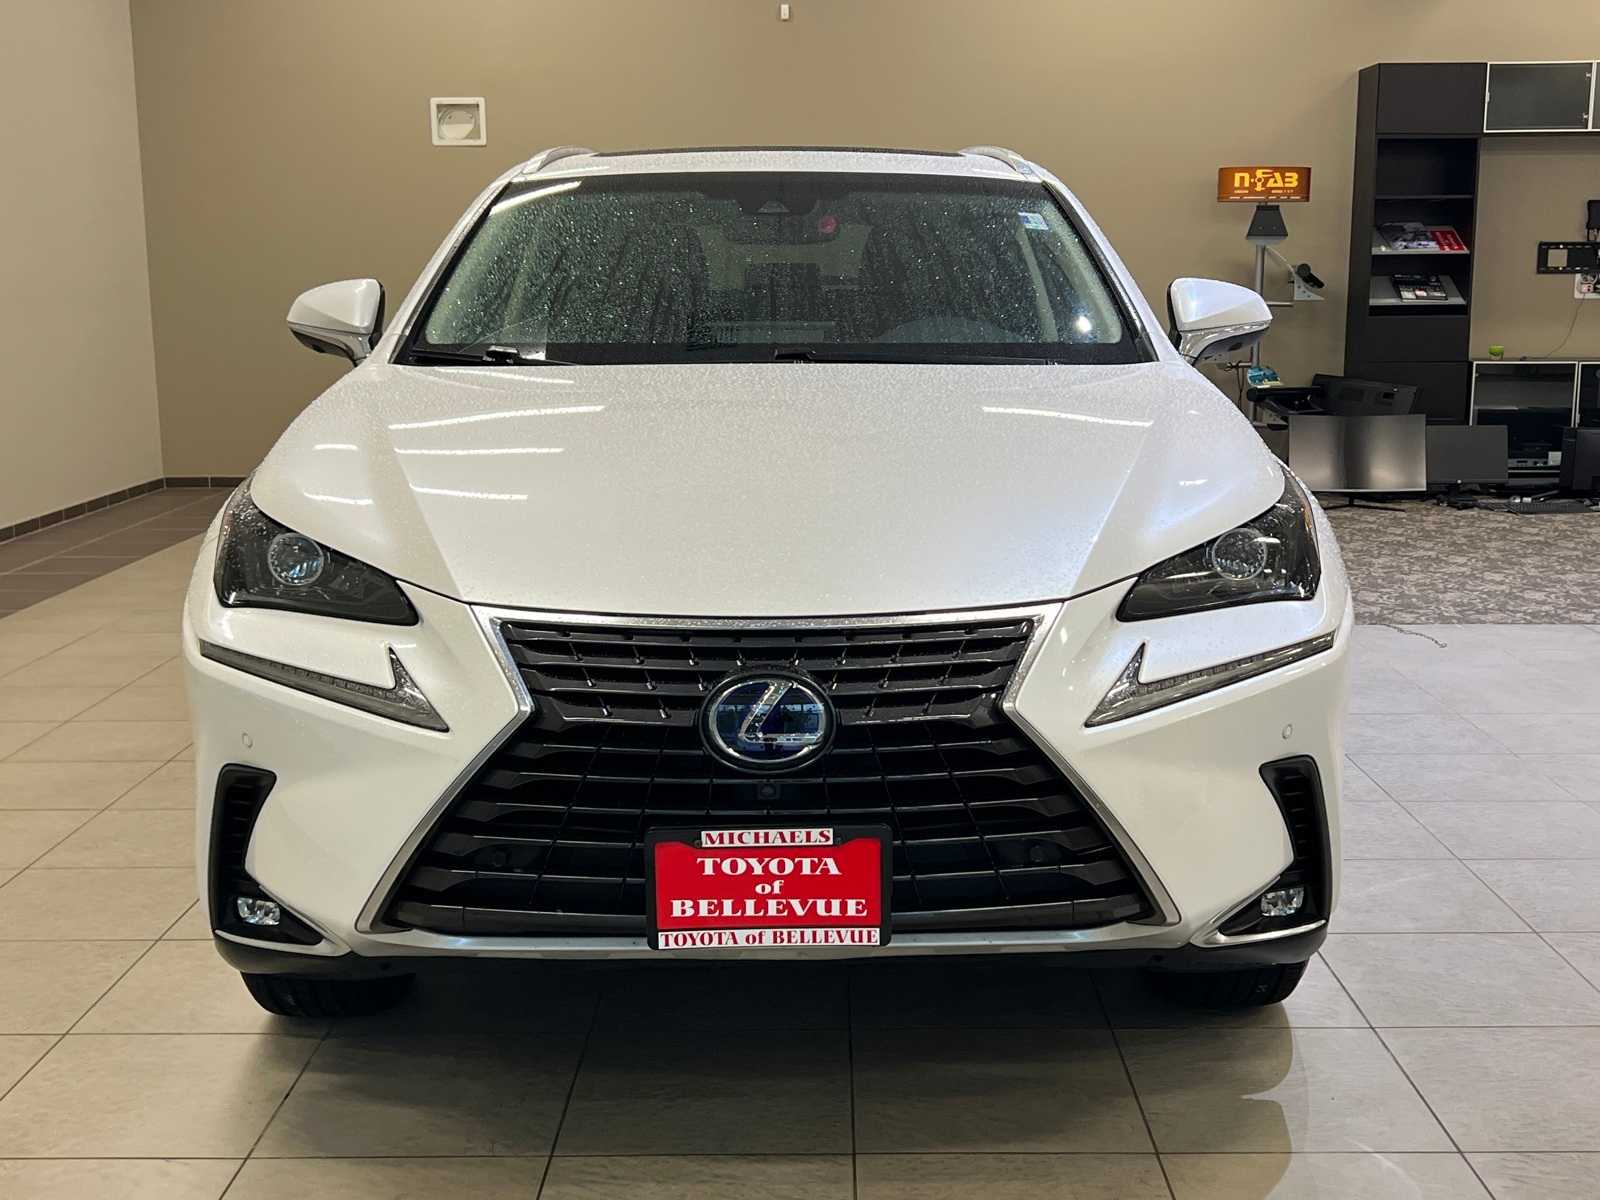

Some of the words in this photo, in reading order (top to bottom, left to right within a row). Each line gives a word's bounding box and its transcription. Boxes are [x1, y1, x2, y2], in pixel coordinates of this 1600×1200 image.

[704, 830, 832, 845] MICHAELS
[697, 857, 841, 875] TOYOTA
[755, 880, 784, 895] of
[671, 899, 867, 917] BELLEVUE
[661, 932, 739, 947] TOYOTA
[745, 931, 766, 945] of
[772, 929, 878, 945] BELLEVUE
